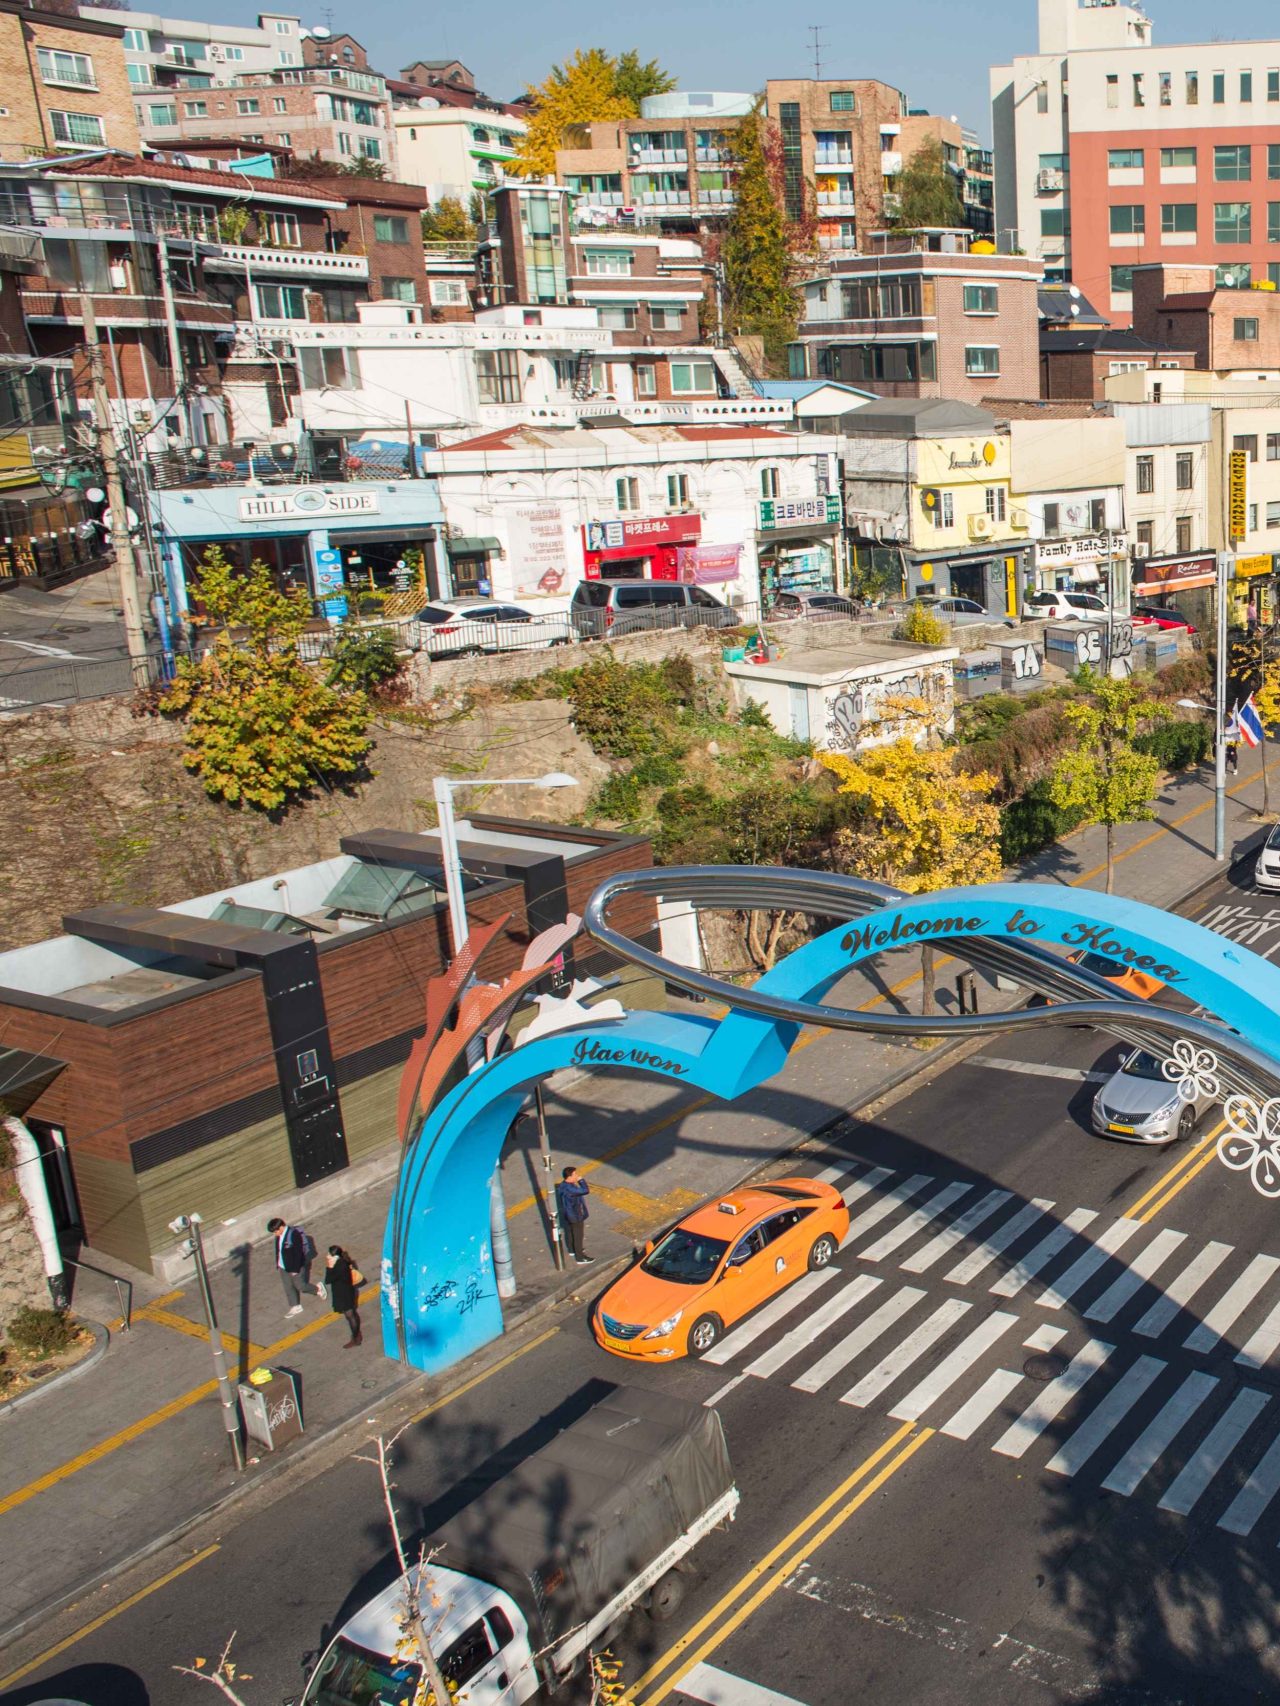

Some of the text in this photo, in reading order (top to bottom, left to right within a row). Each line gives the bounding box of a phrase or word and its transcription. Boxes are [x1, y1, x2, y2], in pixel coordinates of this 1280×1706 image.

[1232, 453, 1247, 527] MONEY EXCHANGE
[246, 495, 373, 516] HILL SIDE
[777, 500, 825, 519] 크로바만물
[625, 521, 670, 535] 마켓프레스
[1039, 542, 1072, 558] Family
[1076, 540, 1098, 552] Hair
[1177, 562, 1201, 574] Rodeo
[1011, 643, 1041, 680] TA
[840, 909, 1190, 983] Welcome to Korea
[570, 1036, 690, 1076] Itaewon
